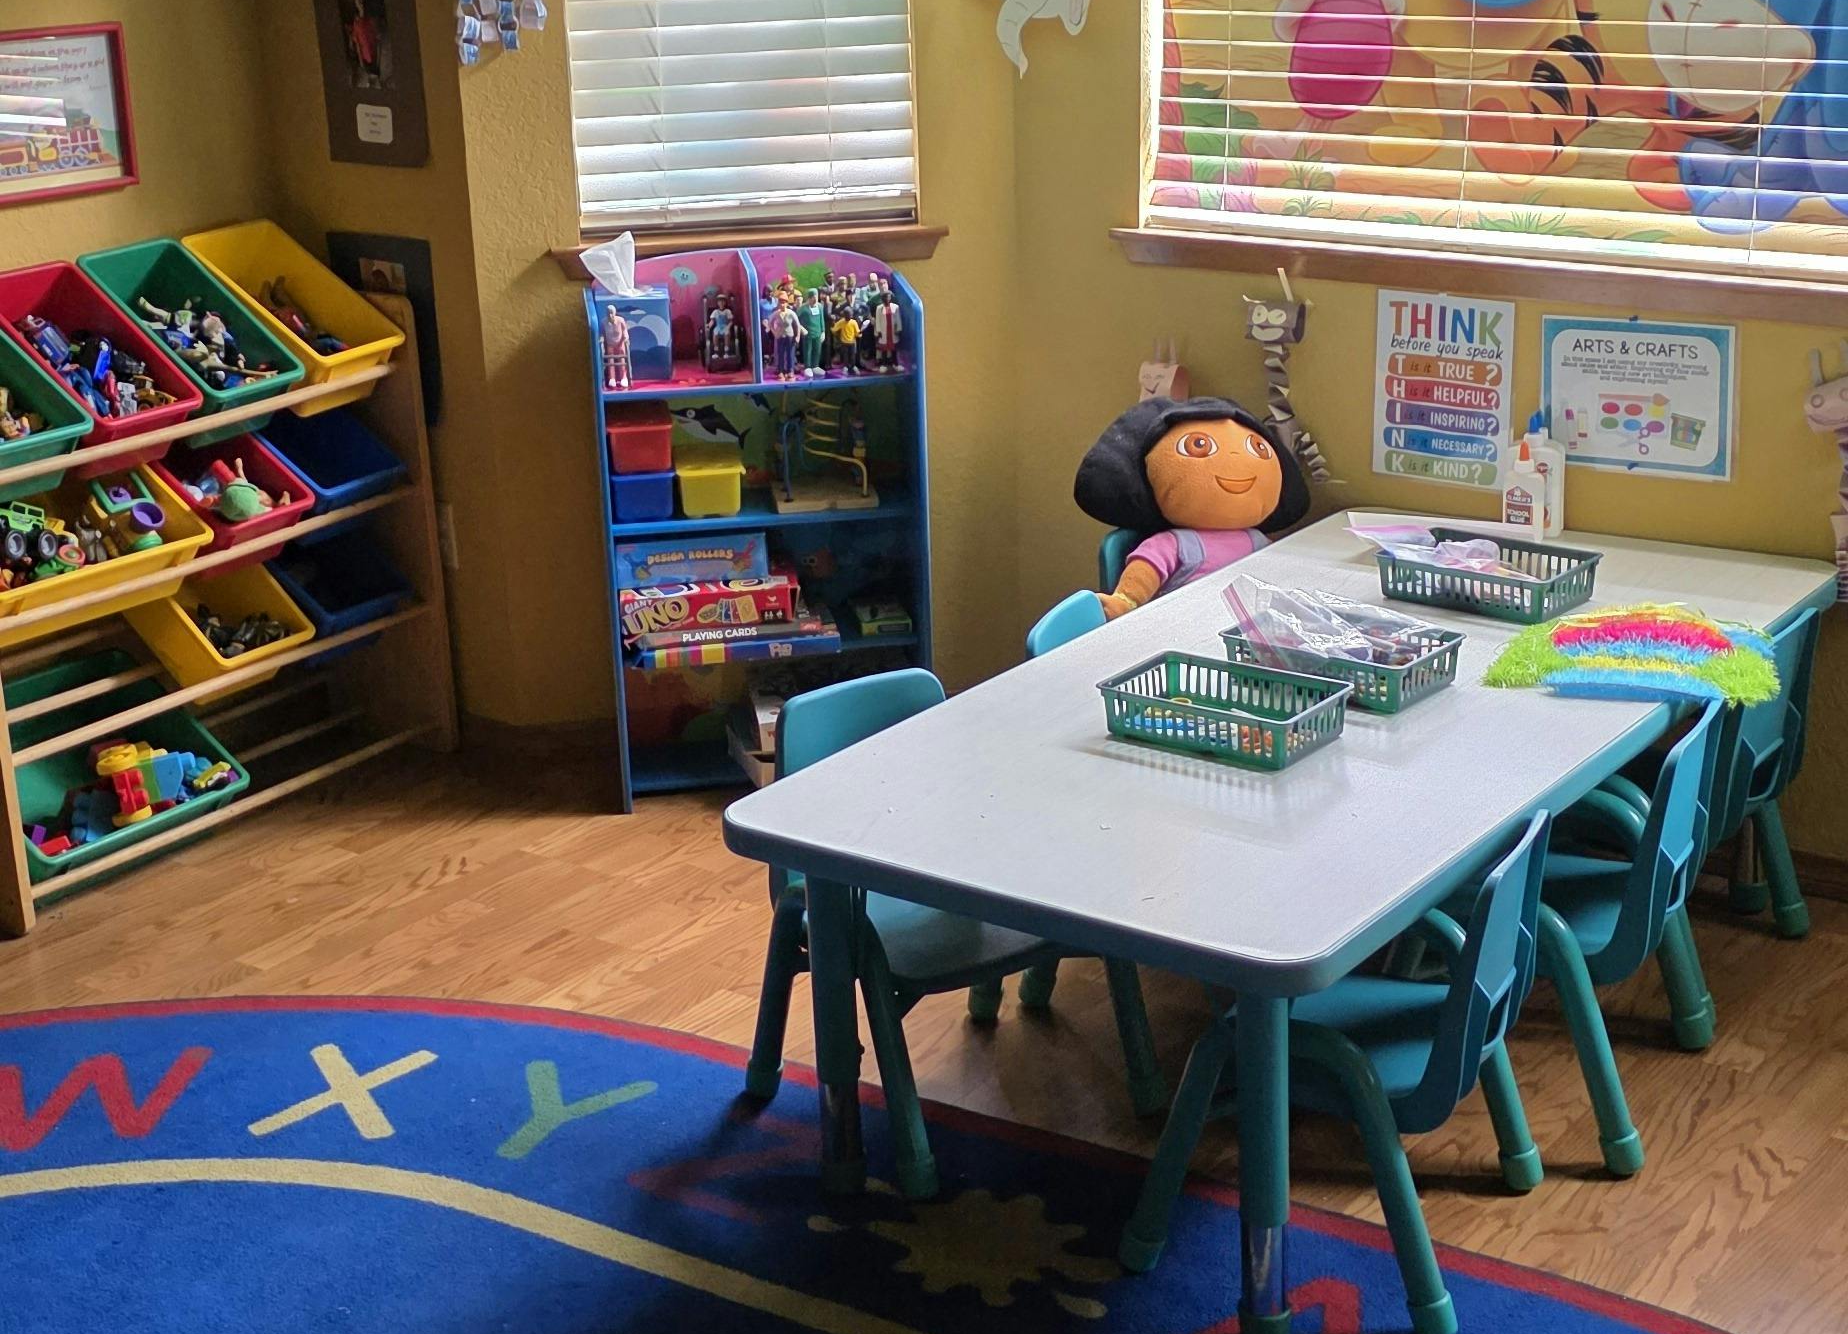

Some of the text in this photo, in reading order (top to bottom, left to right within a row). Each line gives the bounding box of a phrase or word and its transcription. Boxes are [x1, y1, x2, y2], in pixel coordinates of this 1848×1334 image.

[1389, 300, 1504, 347] THINK
[1391, 333, 1504, 361] before you speak
[1572, 338, 1699, 360] ARTS & CRAFTS
[1395, 354, 1406, 375] T
[1393, 379, 1406, 399] H
[1395, 402, 1401, 423] I
[1391, 428, 1405, 448] N
[1391, 453, 1405, 472] K
[647, 548, 734, 565] DESIGN ROLLERS
[623, 596, 690, 635] UNO
[624, 599, 653, 614] GIANT
[682, 627, 758, 643] PLAYING CARDS
[0, 1045, 213, 1152] W
[248, 1043, 439, 1140] X
[496, 1060, 658, 1160] Y
